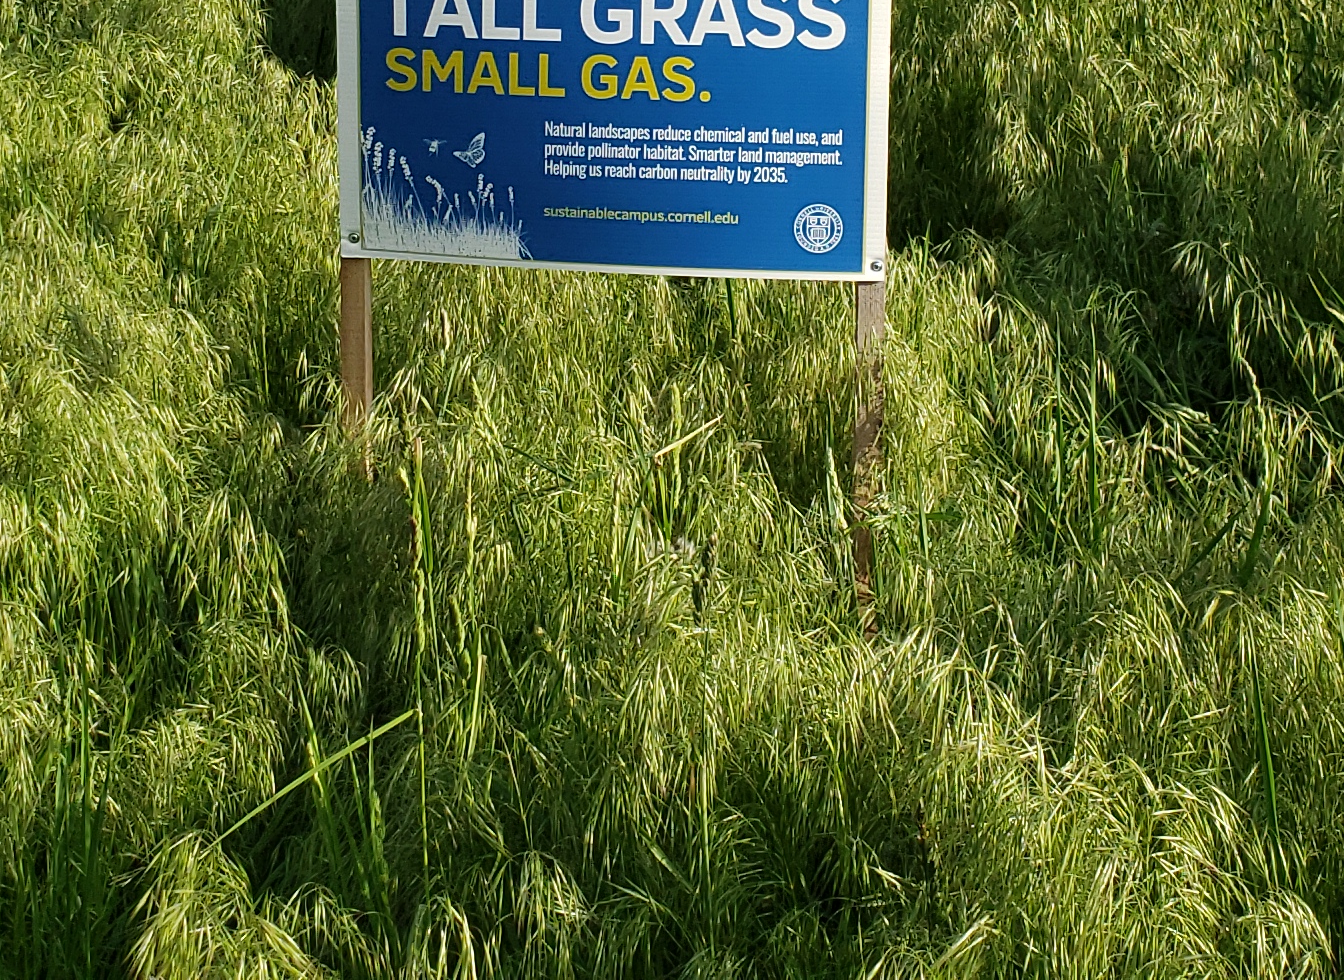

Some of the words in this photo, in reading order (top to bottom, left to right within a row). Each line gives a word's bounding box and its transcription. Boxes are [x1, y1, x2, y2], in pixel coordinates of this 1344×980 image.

[385, 47, 566, 98] SMALL
[581, 54, 711, 103] GAS.
[544, 121, 586, 138] Natural
[588, 122, 650, 143] landscapes
[652, 125, 691, 141] reduce
[693, 126, 745, 143] chemical
[747, 127, 769, 144] and
[771, 128, 794, 145] fuel
[795, 130, 819, 147] use,
[821, 129, 843, 146] and
[544, 141, 586, 159] provide
[587, 142, 641, 161] pollinator
[643, 144, 687, 161] habitat.
[688, 145, 736, 163] Smarter
[738, 146, 763, 163] land
[765, 150, 843, 168] management.
[544, 159, 587, 179] Helping
[589, 164, 603, 177] us
[604, 162, 637, 179] reach
[638, 163, 678, 180] carbon
[680, 166, 735, 184] neutrality
[736, 166, 752, 184] by
[753, 166, 788, 183] 2035.
[543, 206, 739, 225] sustainablecampus.cornell.edu
